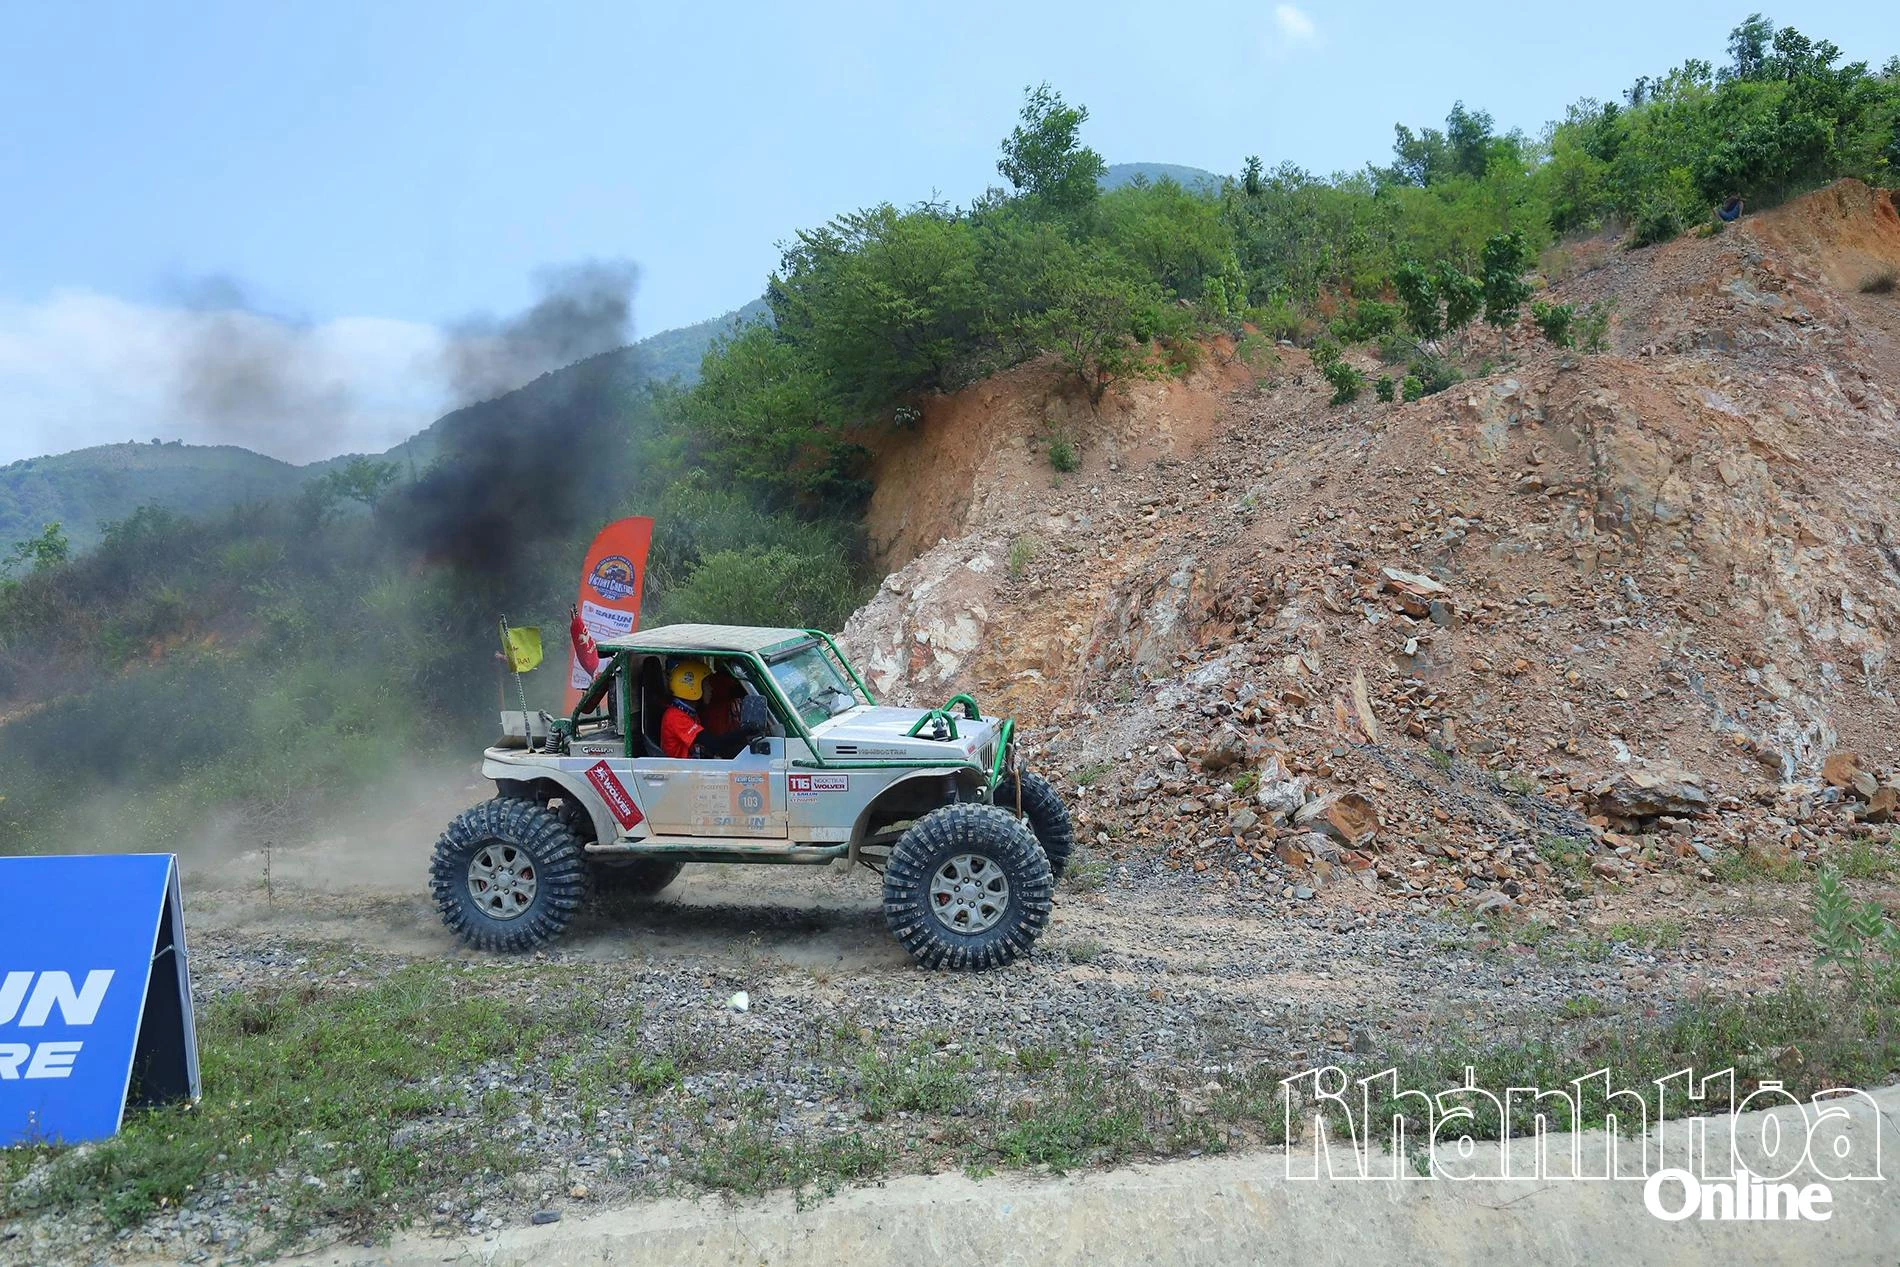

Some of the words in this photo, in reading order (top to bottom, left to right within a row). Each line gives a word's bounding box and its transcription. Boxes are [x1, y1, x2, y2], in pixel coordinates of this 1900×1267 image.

[595, 609, 633, 623] SAILUN
[790, 778, 810, 789] 116
[603, 777, 631, 817] WOLVER
[743, 796, 758, 807] 103
[713, 817, 766, 826] SAIUN
